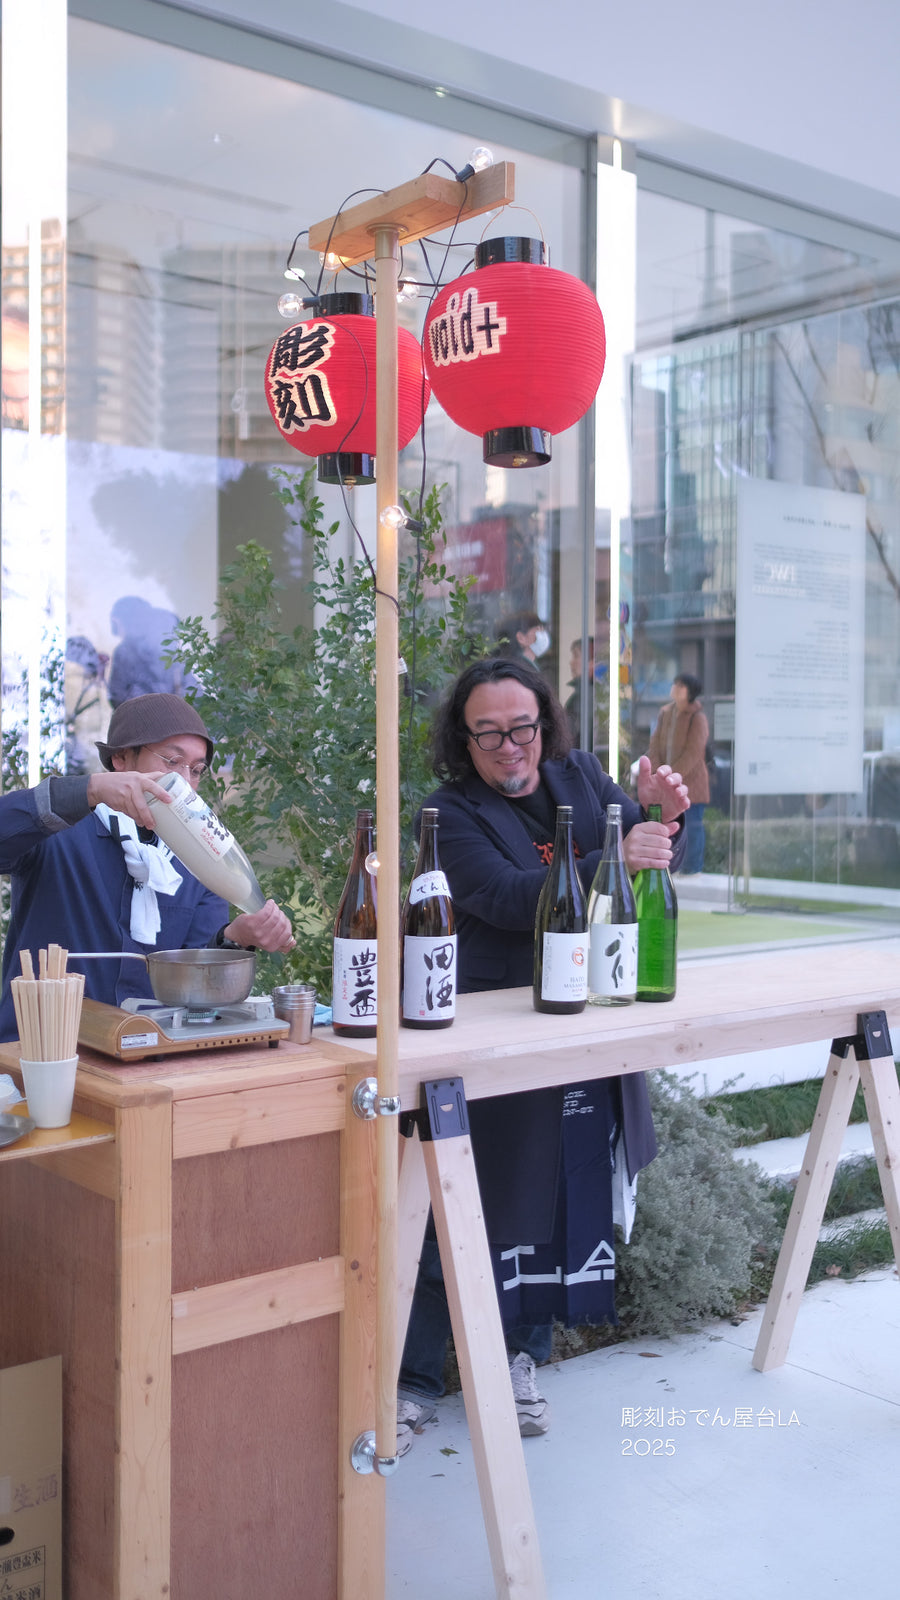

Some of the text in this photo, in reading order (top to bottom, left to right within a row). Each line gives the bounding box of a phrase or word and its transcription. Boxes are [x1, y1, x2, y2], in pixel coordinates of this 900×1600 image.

[430, 291, 500, 361] void+
[271, 325, 332, 430] 彫刻
[423, 942, 454, 1011] 田酒
